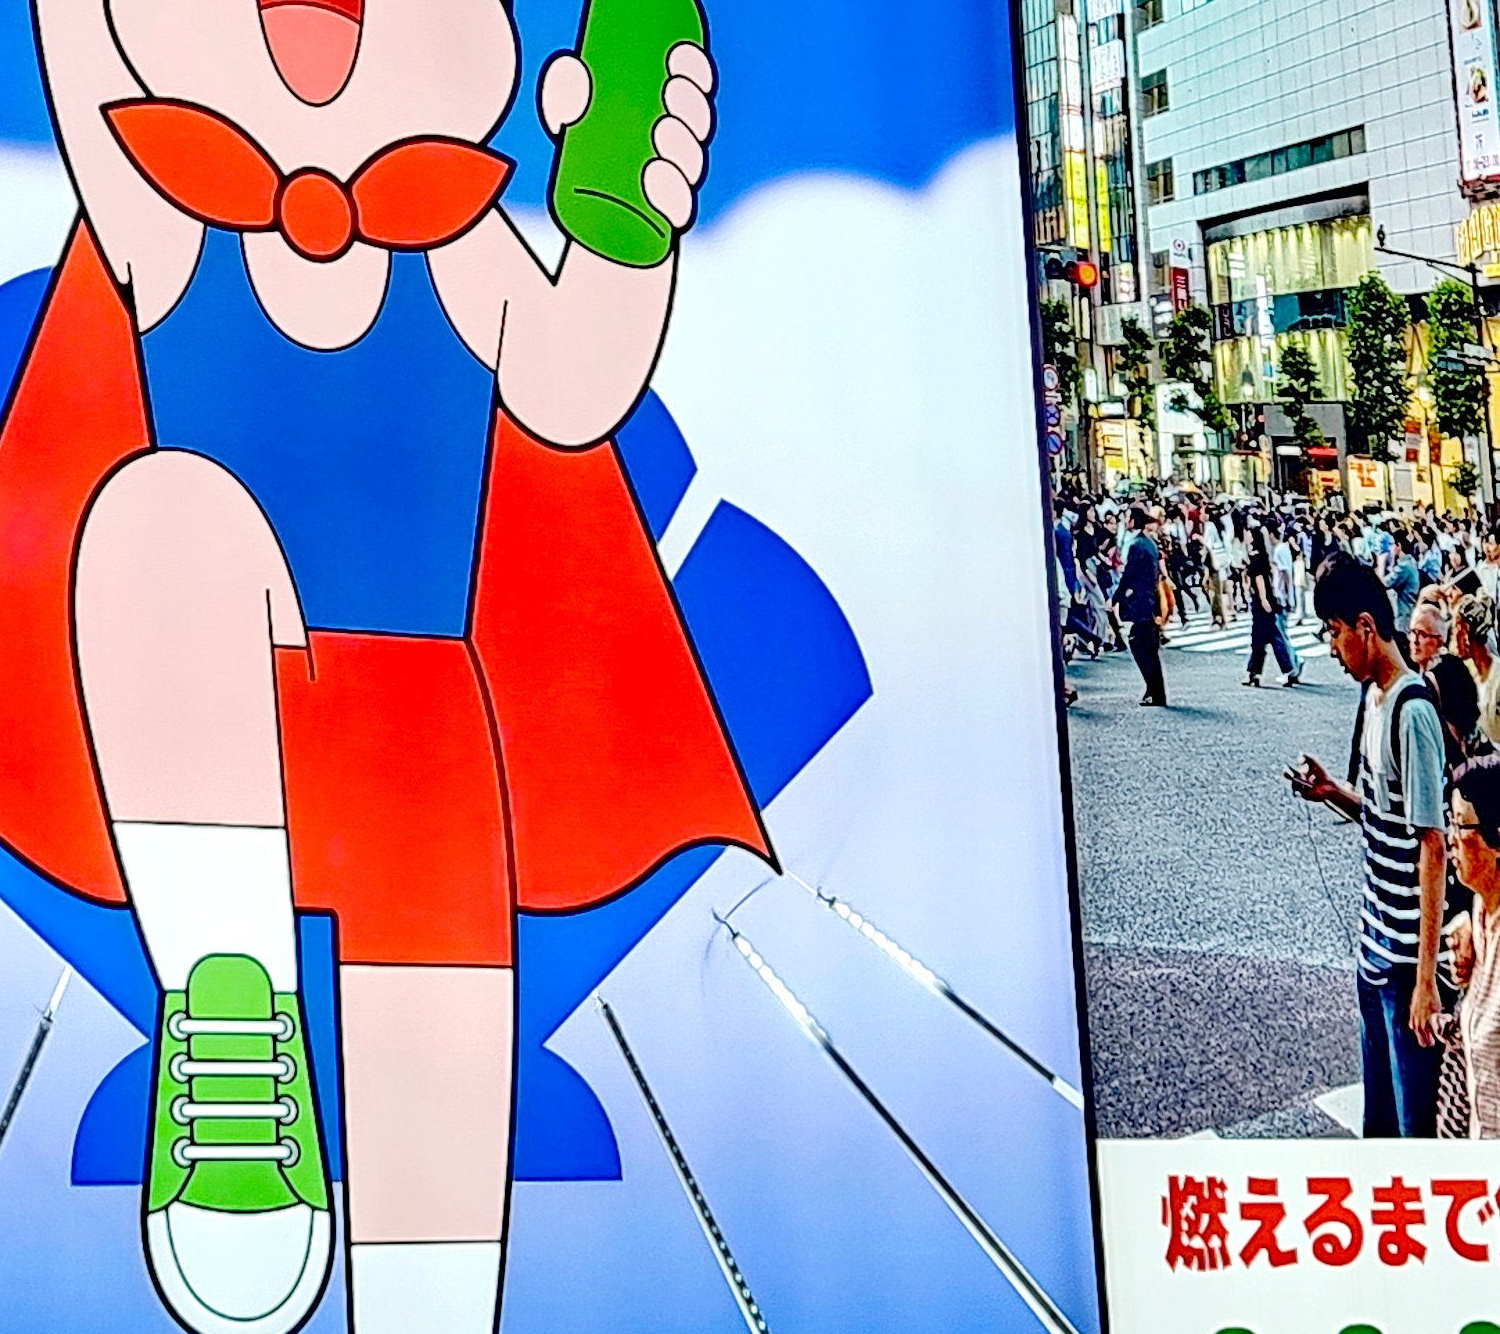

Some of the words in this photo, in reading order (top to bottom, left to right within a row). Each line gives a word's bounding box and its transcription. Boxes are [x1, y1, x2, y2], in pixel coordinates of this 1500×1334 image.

[1160, 1174, 1500, 1273] 燃えるまで
